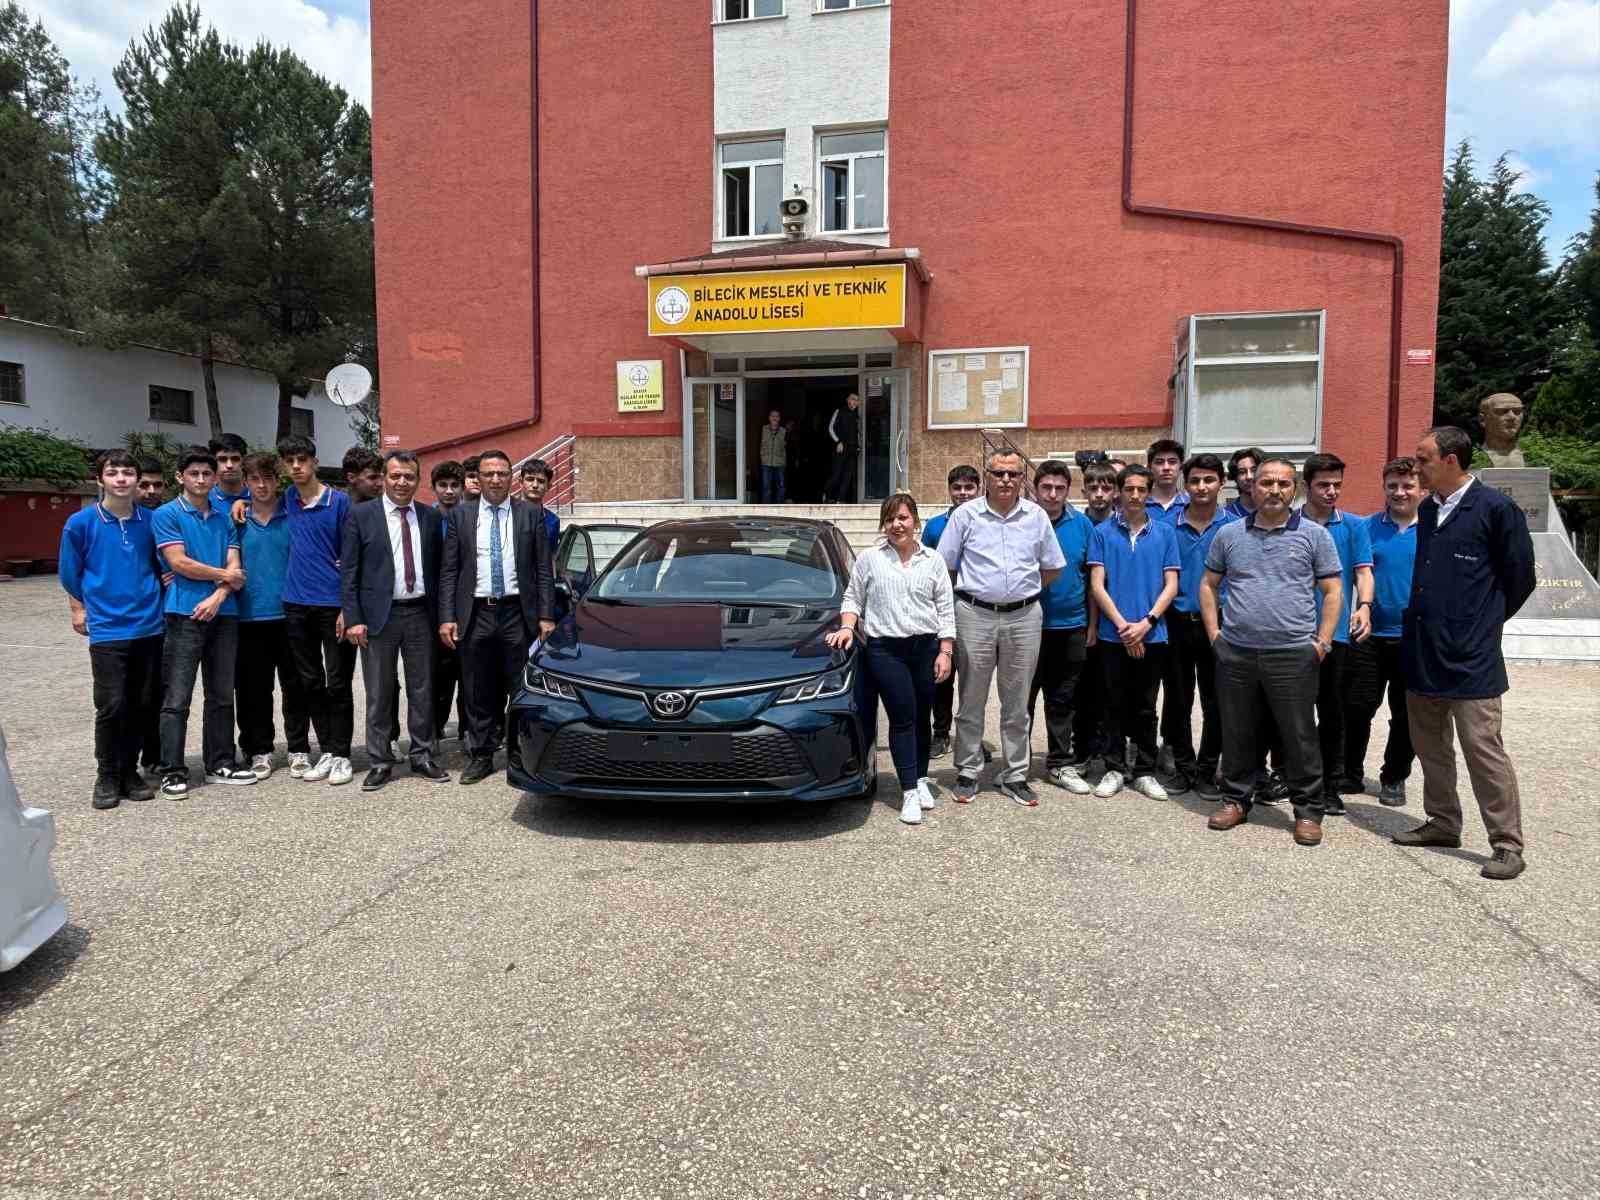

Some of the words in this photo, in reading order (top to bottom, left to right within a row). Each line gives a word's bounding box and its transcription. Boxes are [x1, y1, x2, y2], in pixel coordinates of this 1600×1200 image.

[694, 285, 746, 302] BİLECİK
[749, 281, 809, 300] MESLEKİ
[813, 283, 831, 297] VE
[834, 277, 887, 297] TEKNİK
[694, 306, 758, 322] ANADOLU
[762, 302, 804, 319] LİSESİ
